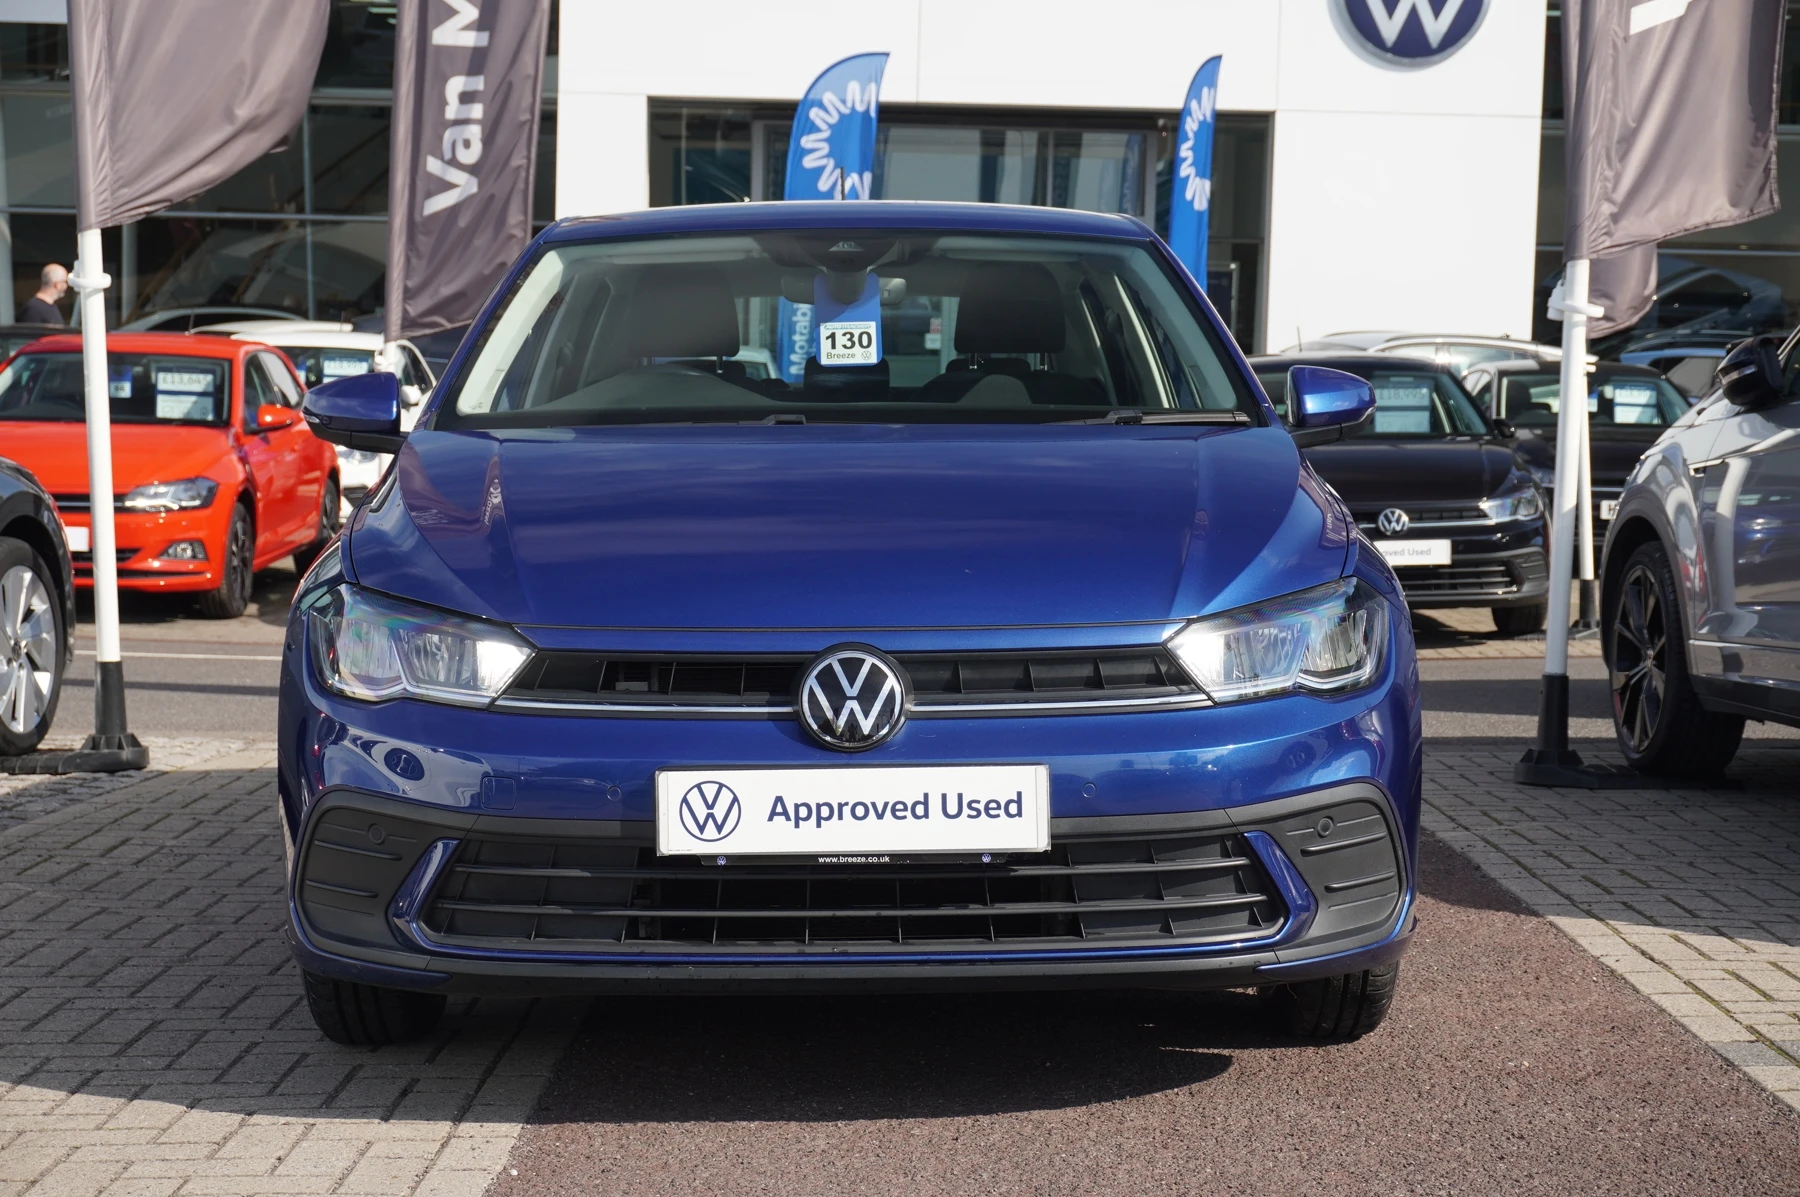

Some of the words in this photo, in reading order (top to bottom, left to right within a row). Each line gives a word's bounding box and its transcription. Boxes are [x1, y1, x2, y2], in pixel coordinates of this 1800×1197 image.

[422, 74, 485, 217] Van
[788, 303, 812, 375] Motabi
[825, 331, 873, 350] 130
[1407, 547, 1432, 556] Used
[767, 792, 930, 829] Approved
[940, 790, 1023, 820] Used
[818, 855, 890, 864] www.breeze.co.uk
